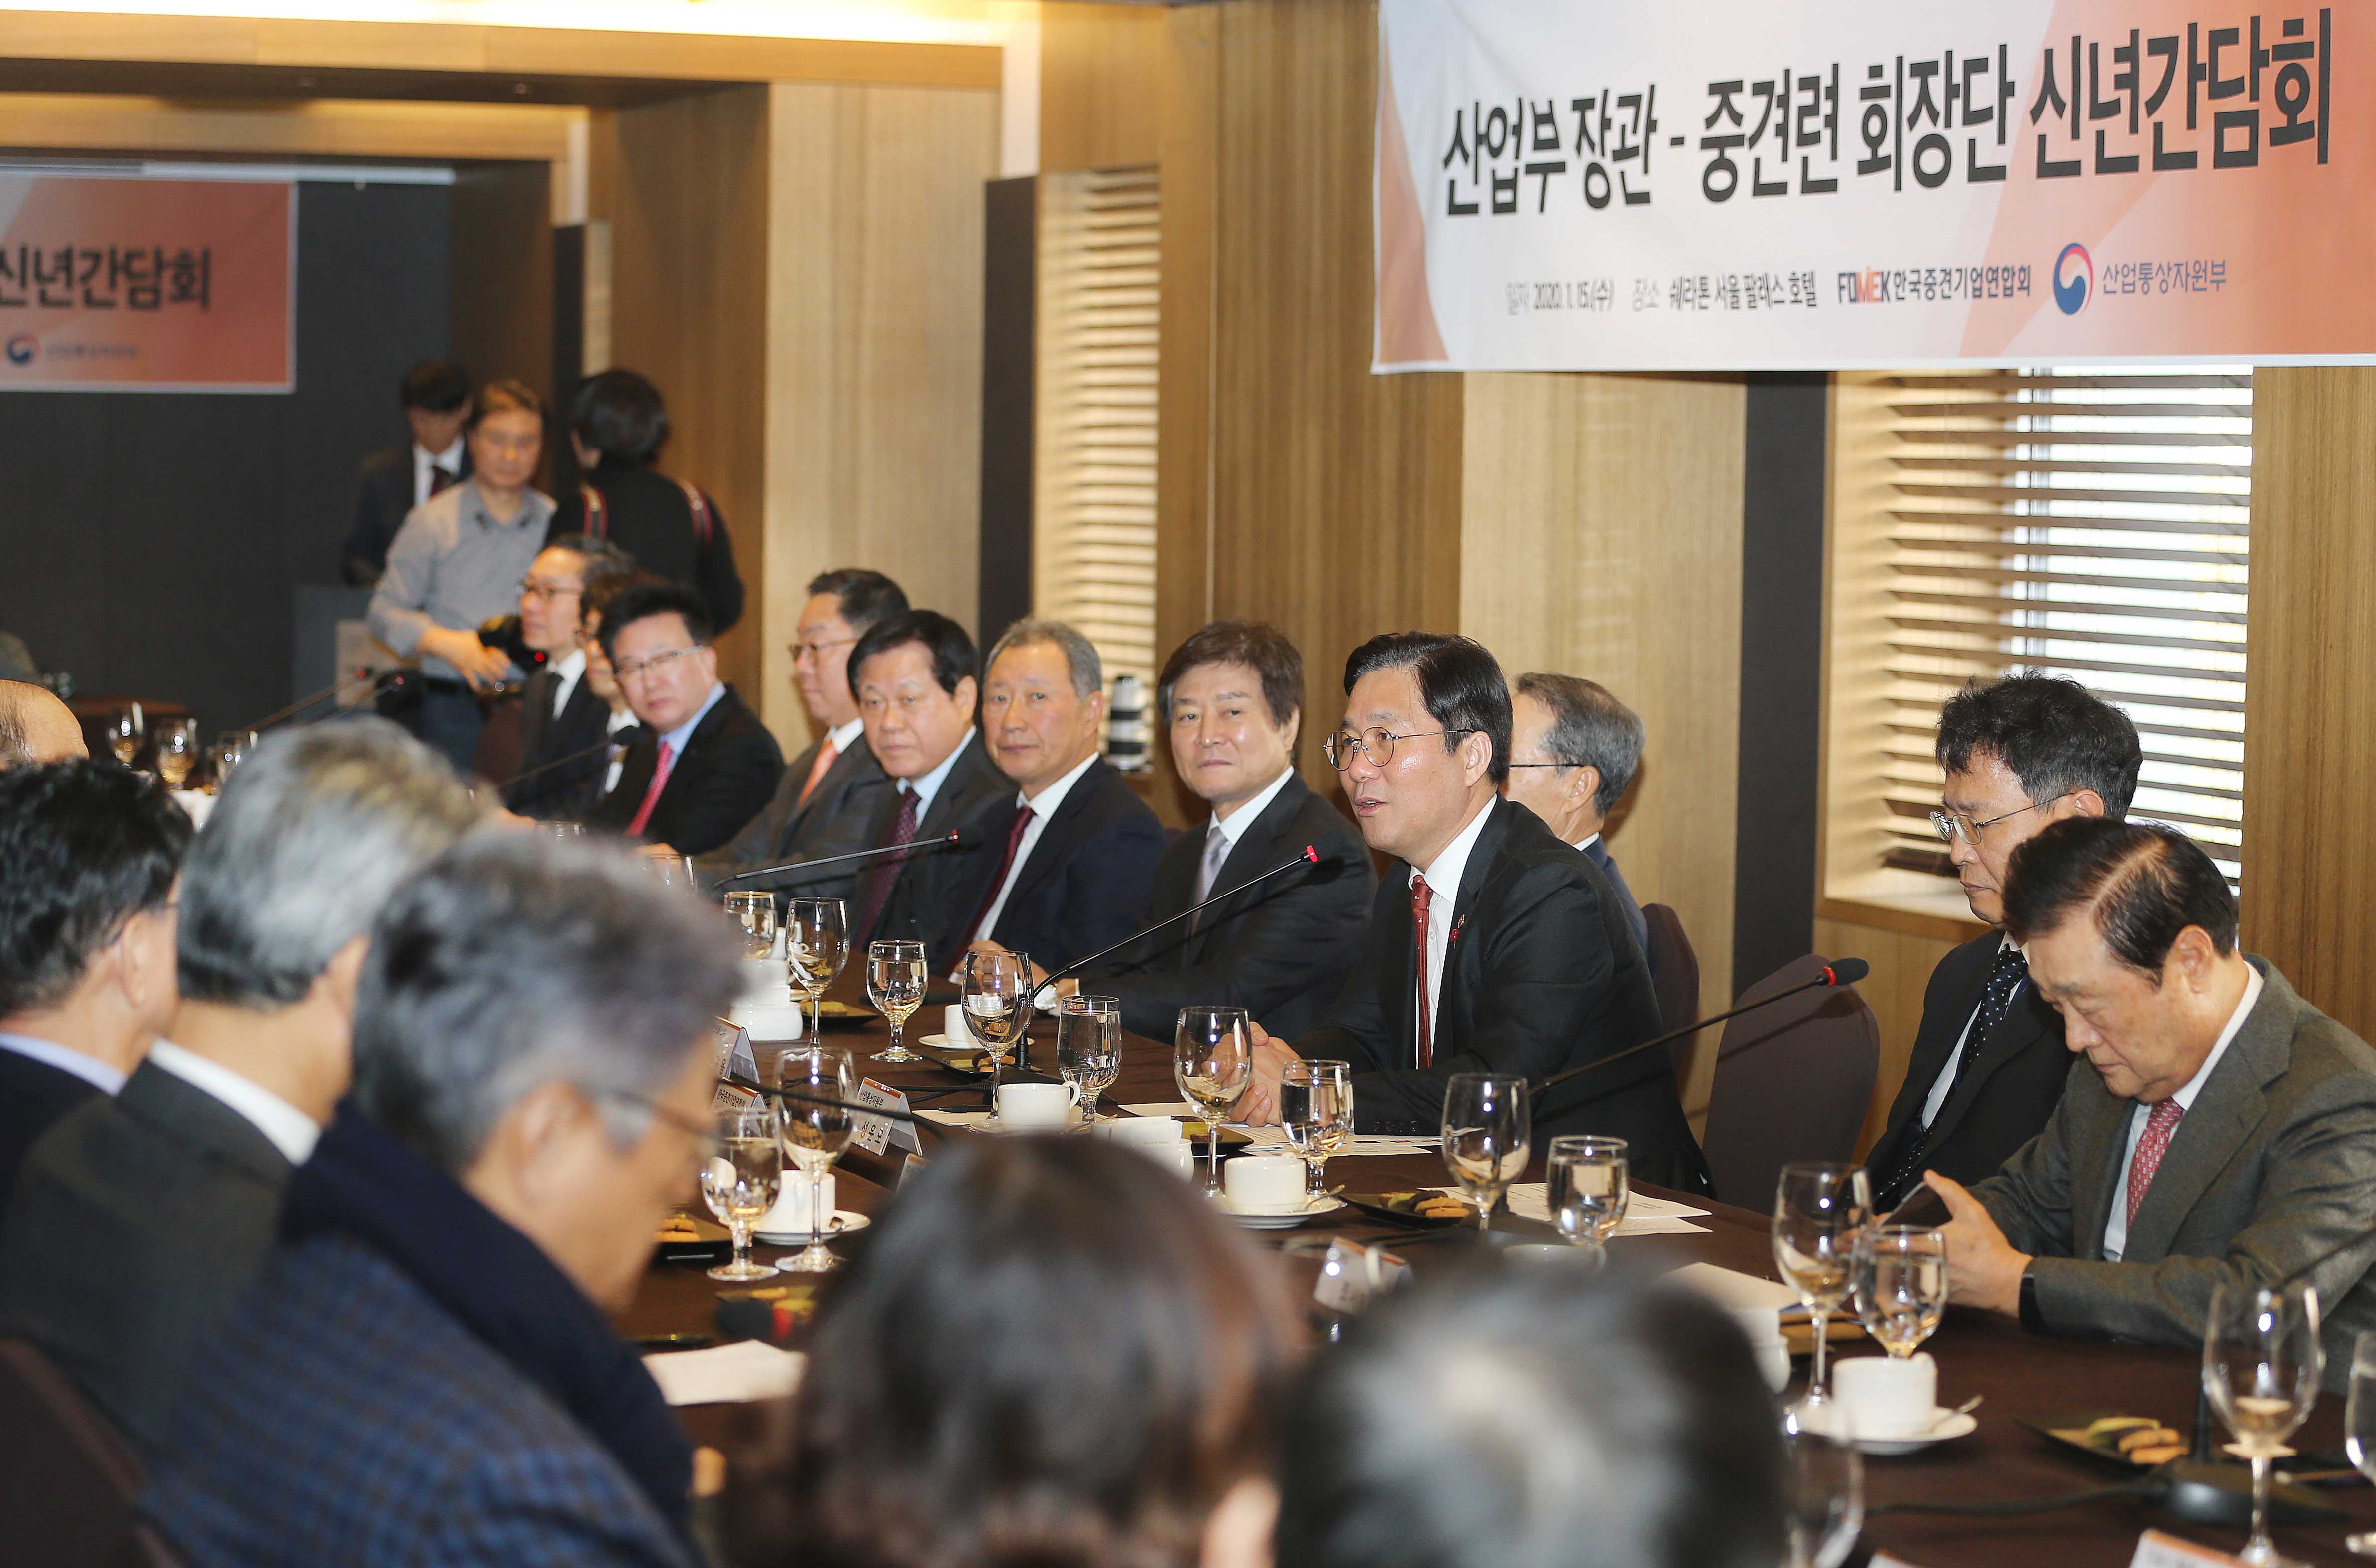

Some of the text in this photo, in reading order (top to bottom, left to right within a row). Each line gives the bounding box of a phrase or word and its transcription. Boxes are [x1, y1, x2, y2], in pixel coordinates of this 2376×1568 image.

[1443, 97, 1566, 215] 산업부
[1572, 84, 1657, 209] 장관
[1700, 63, 1839, 202] 중견련
[1857, 43, 2015, 192] 회장단
[2030, 7, 2331, 179] 신년간담회
[1632, 277, 1660, 312] 장소
[1669, 275, 1710, 312] 쉐라톤
[1714, 273, 1740, 311] 서울
[1743, 271, 1785, 309] 팔래스
[1788, 270, 1817, 308] 호텔
[1893, 264, 2032, 302] 한국중견기업연합회
[2102, 258, 2227, 296] 산업통상자원부
[859, 1090, 884, 1108] 산업통상자원부
